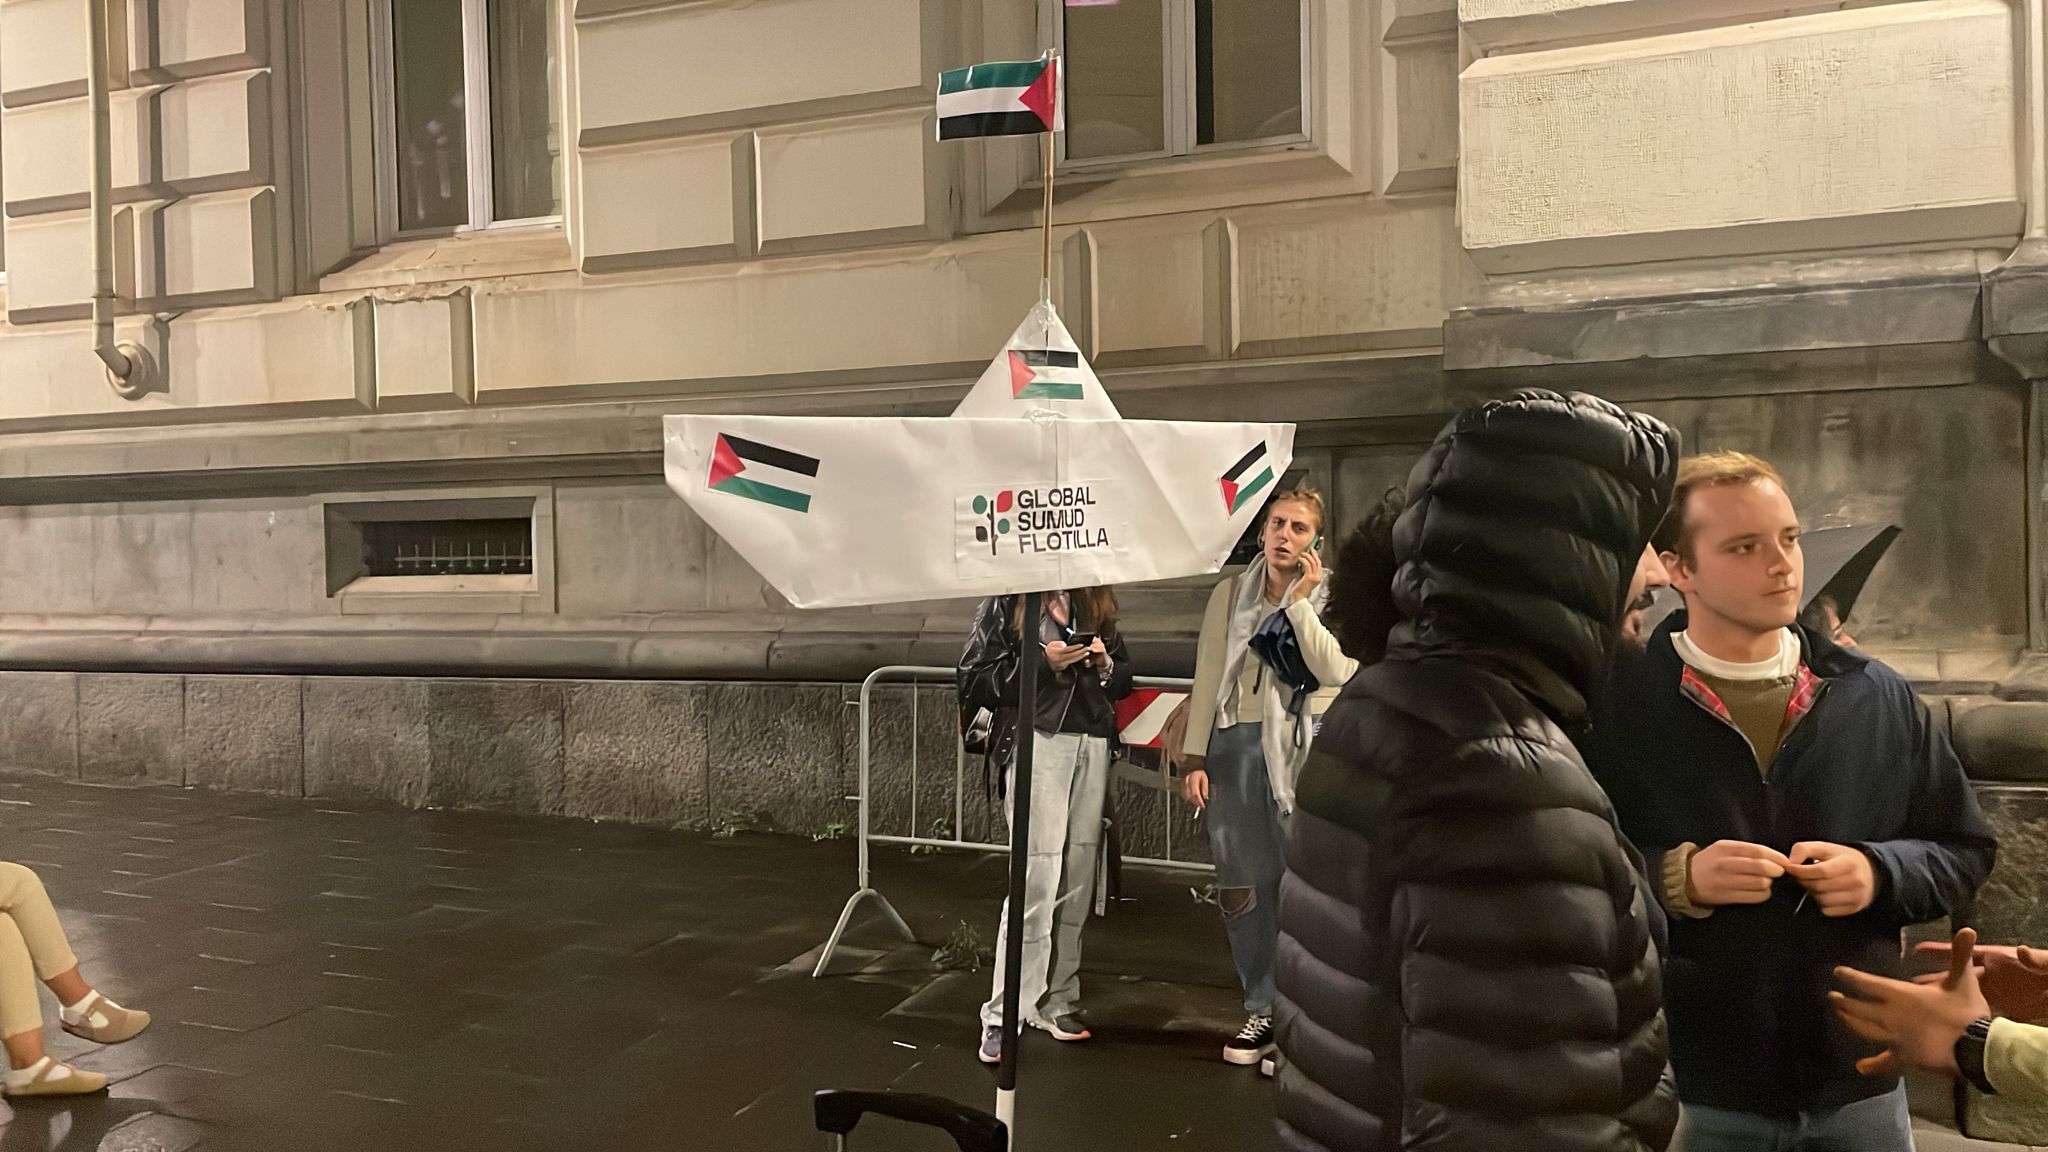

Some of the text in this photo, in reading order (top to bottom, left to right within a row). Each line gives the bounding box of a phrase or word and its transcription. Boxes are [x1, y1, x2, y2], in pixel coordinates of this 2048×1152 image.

[1017, 486, 1096, 509] GLOBAL
[1017, 508, 1085, 532] SUMUD
[1018, 527, 1109, 554] FLOTILLA
